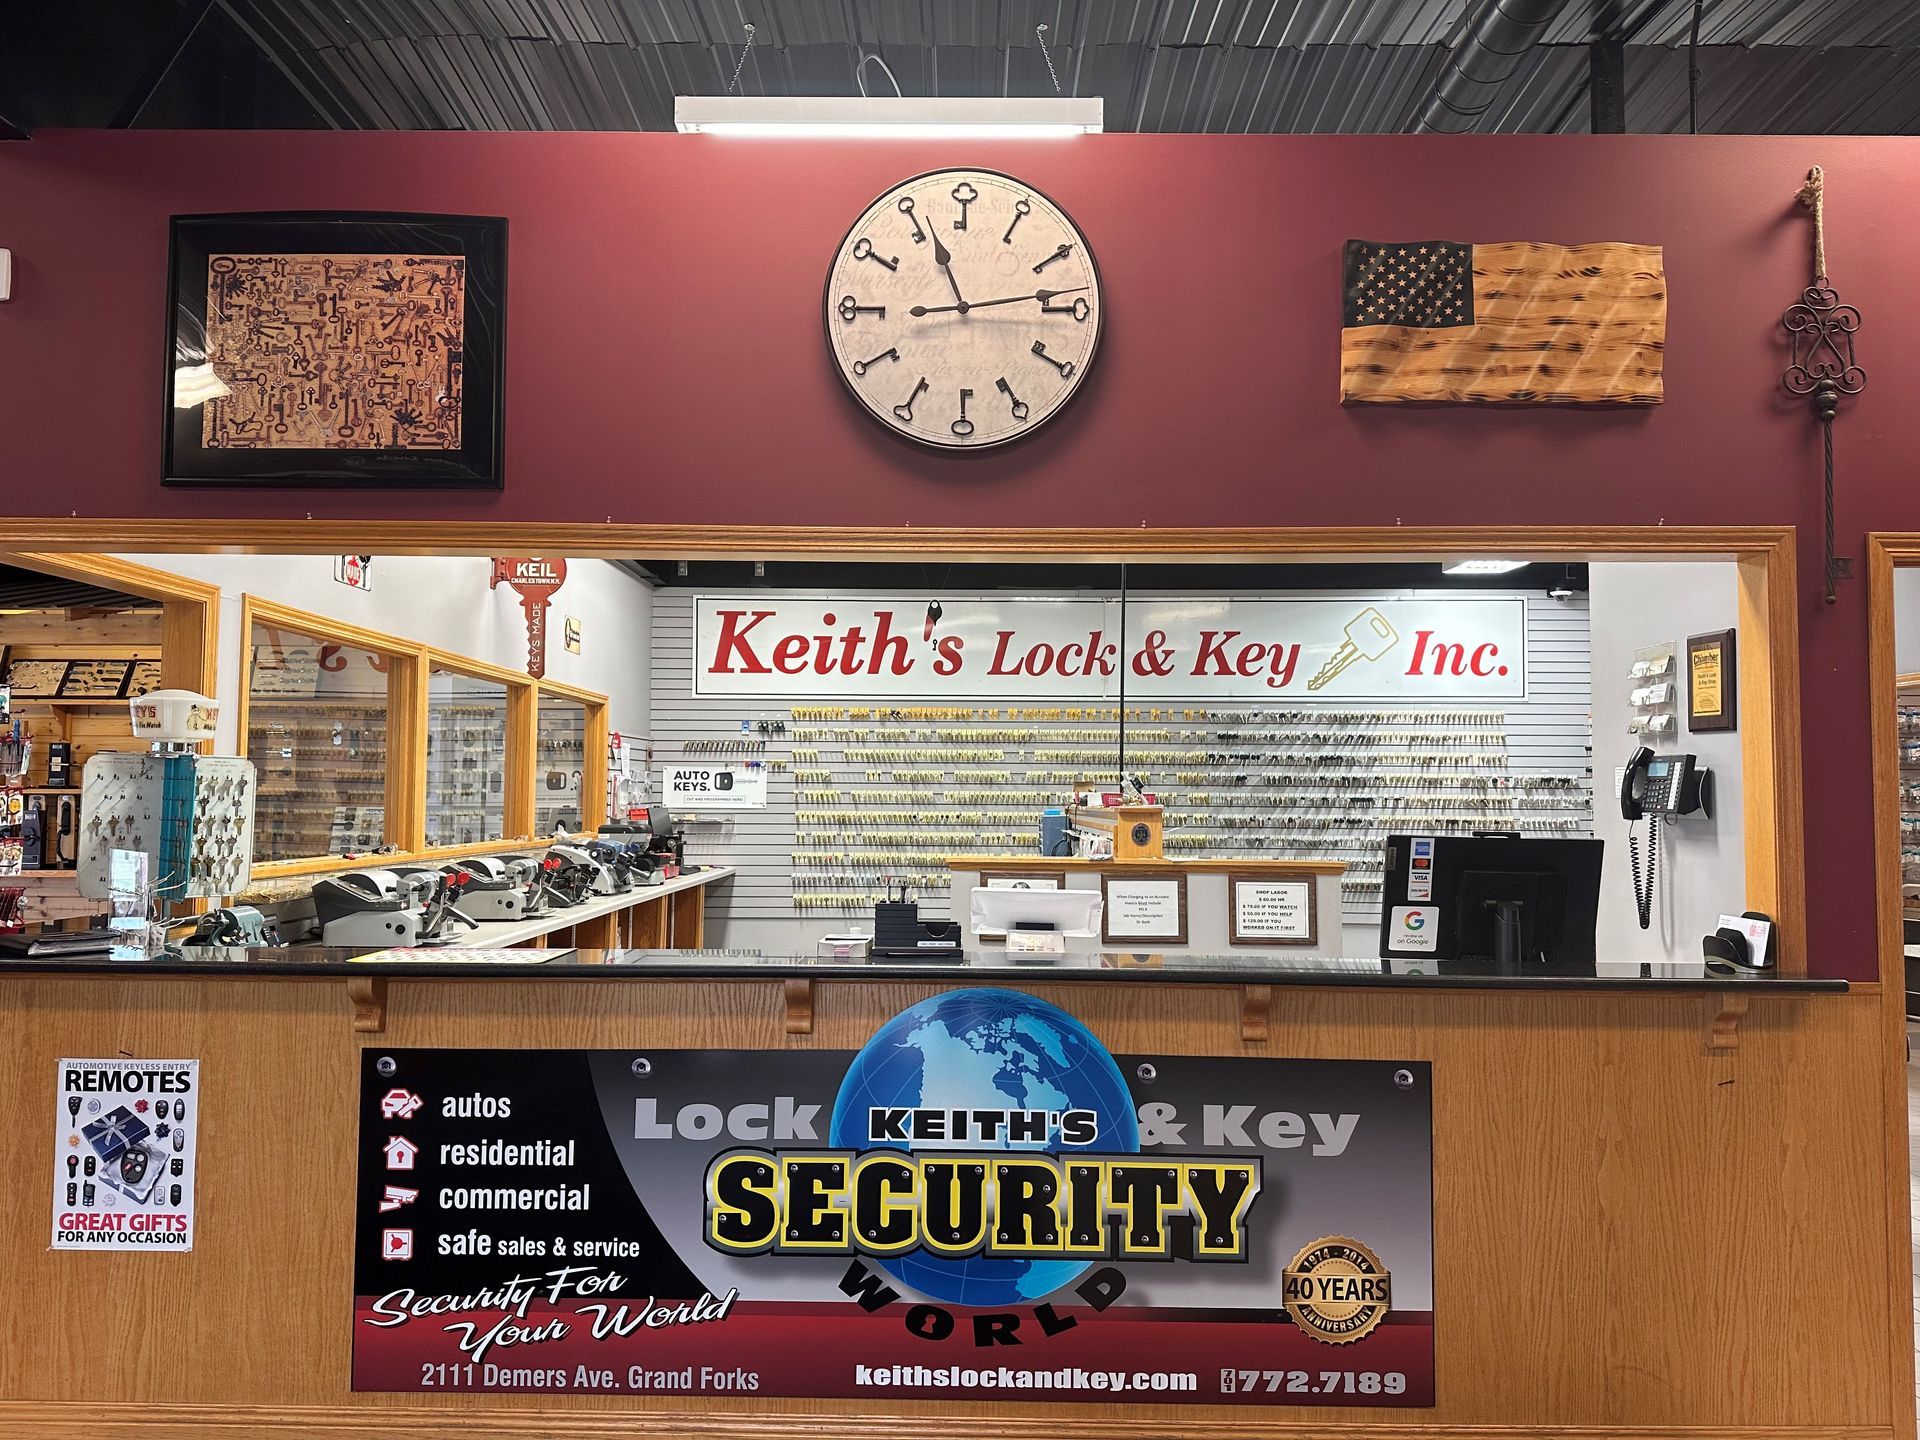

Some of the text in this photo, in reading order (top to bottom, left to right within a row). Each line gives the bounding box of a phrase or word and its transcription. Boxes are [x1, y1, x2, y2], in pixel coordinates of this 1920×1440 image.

[516, 562, 557, 577] KEIL
[531, 602, 541, 672] KEYS MADE
[707, 610, 1509, 688] Keith's Lock & Key Inc.
[136, 704, 157, 718] EYS
[674, 771, 710, 780] AUTO
[674, 781, 711, 791] KEYS.
[66, 1062, 191, 1071] AUTOMOTIVE KEYLESS ENTRY
[65, 1070, 191, 1093] REMOTES
[442, 1092, 511, 1118] autos
[634, 1096, 1361, 1157] Lock & Key
[868, 1106, 1098, 1146] KEITH'S
[440, 1139, 575, 1166] residential
[439, 1184, 590, 1211] commercial
[709, 1155, 1257, 1254] SECURITY
[58, 1212, 187, 1232] GREAT GIFTS
[57, 1231, 187, 1244] FOR ANY OCCASION
[437, 1228, 640, 1257] safe sales & service
[1303, 1248, 1330, 1269] 1974
[1343, 1248, 1369, 1270] 2014
[364, 1265, 628, 1327] Security For
[1286, 1277, 1389, 1301] 40 YEARS
[837, 1258, 1128, 1348] WORLD
[443, 1288, 741, 1363] Your World
[1301, 1306, 1373, 1333] ANNIVERSARY
[421, 1363, 760, 1391] 2111 Demers Ave. Grand Forks
[855, 1364, 1198, 1392] keithslockandkey.com
[1237, 1369, 1407, 1395] 772.7189
